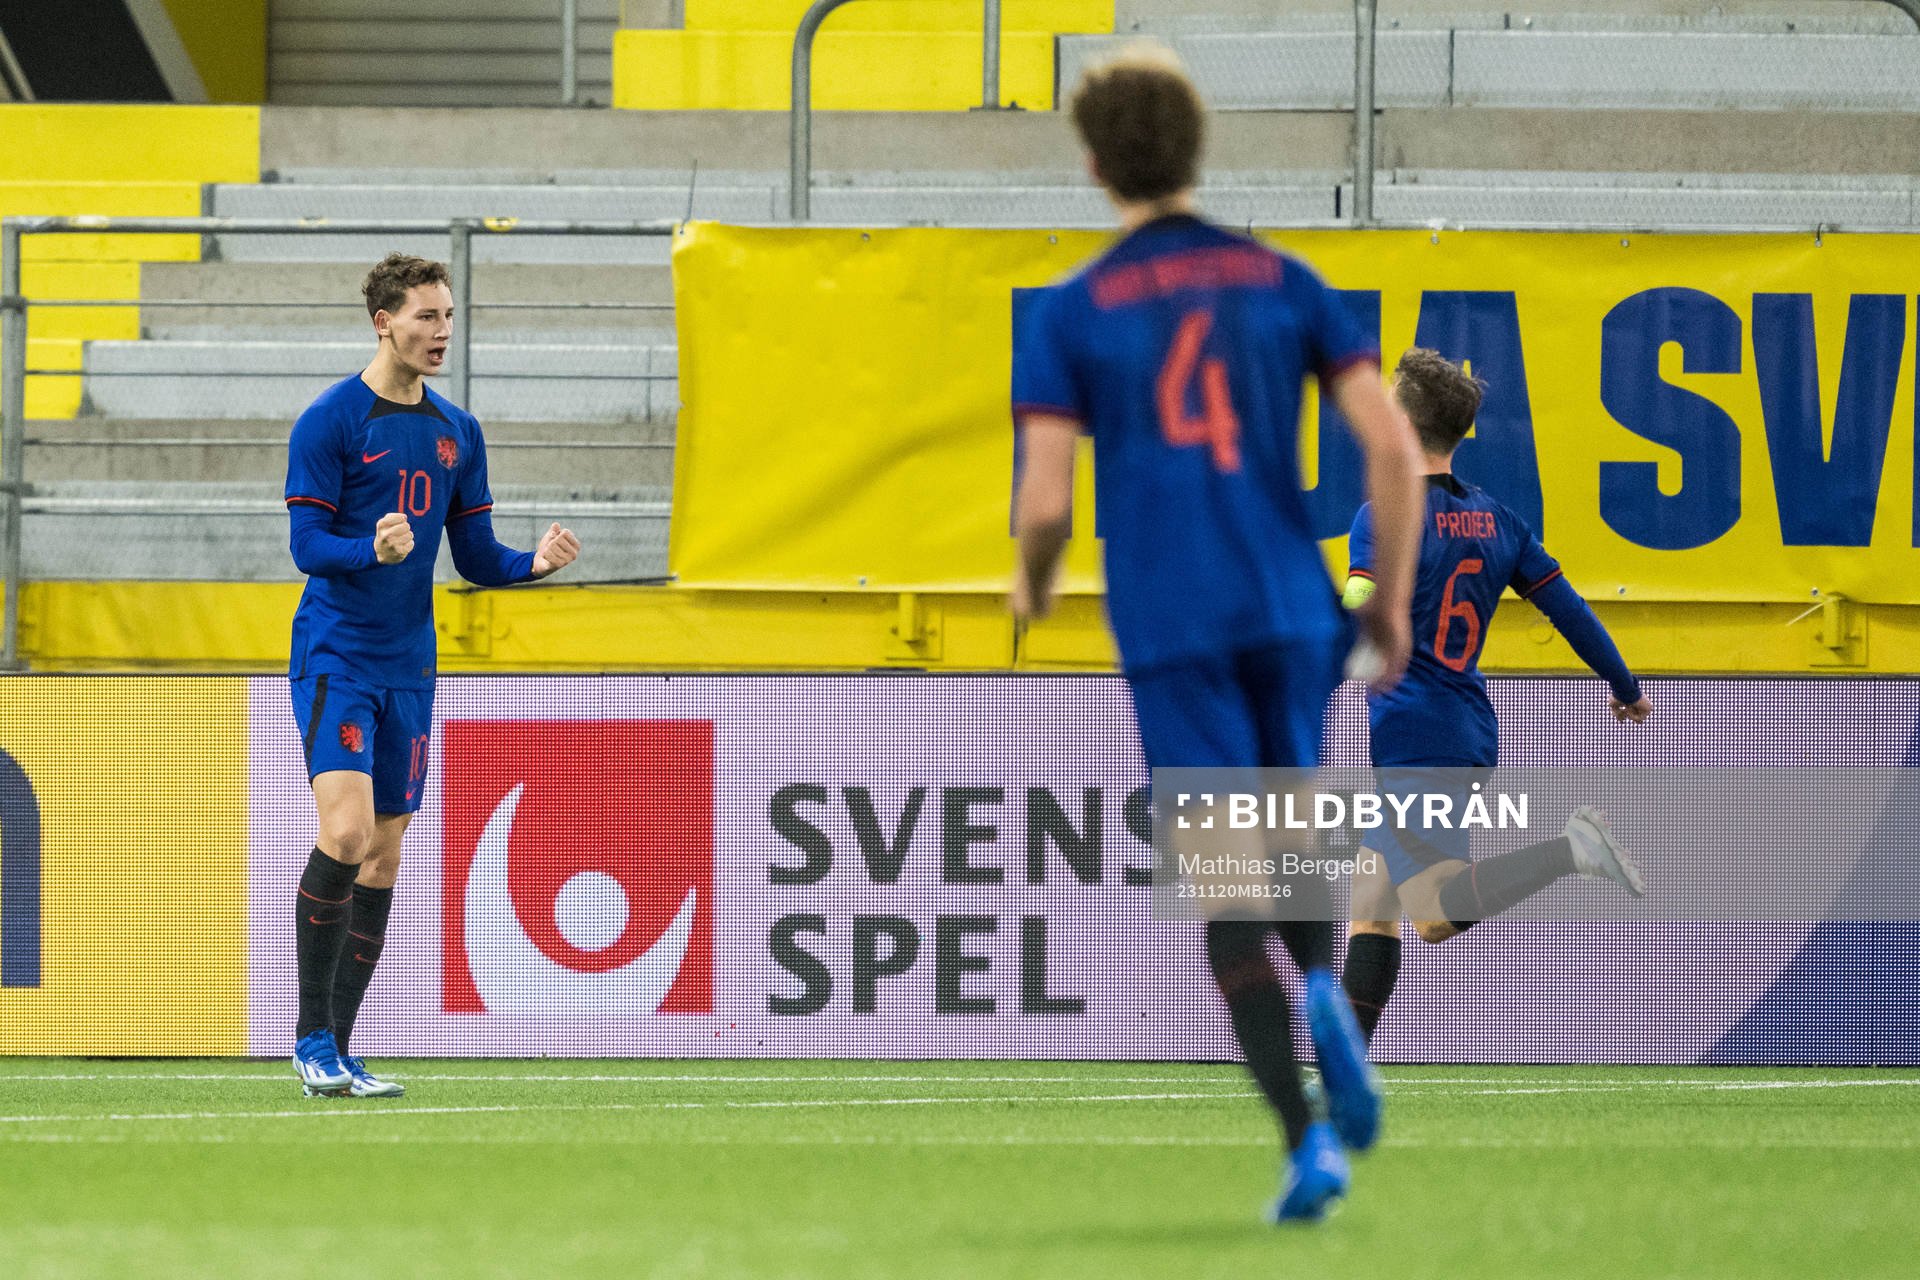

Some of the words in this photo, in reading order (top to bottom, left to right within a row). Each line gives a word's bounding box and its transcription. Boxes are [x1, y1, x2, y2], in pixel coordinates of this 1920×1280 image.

[1155, 309, 1241, 472] 4
[1600, 286, 1920, 550] SV
[398, 469, 432, 516] 10
[1434, 559, 1481, 672] 6
[409, 734, 429, 782] 10
[769, 914, 1087, 1016] SPEL
